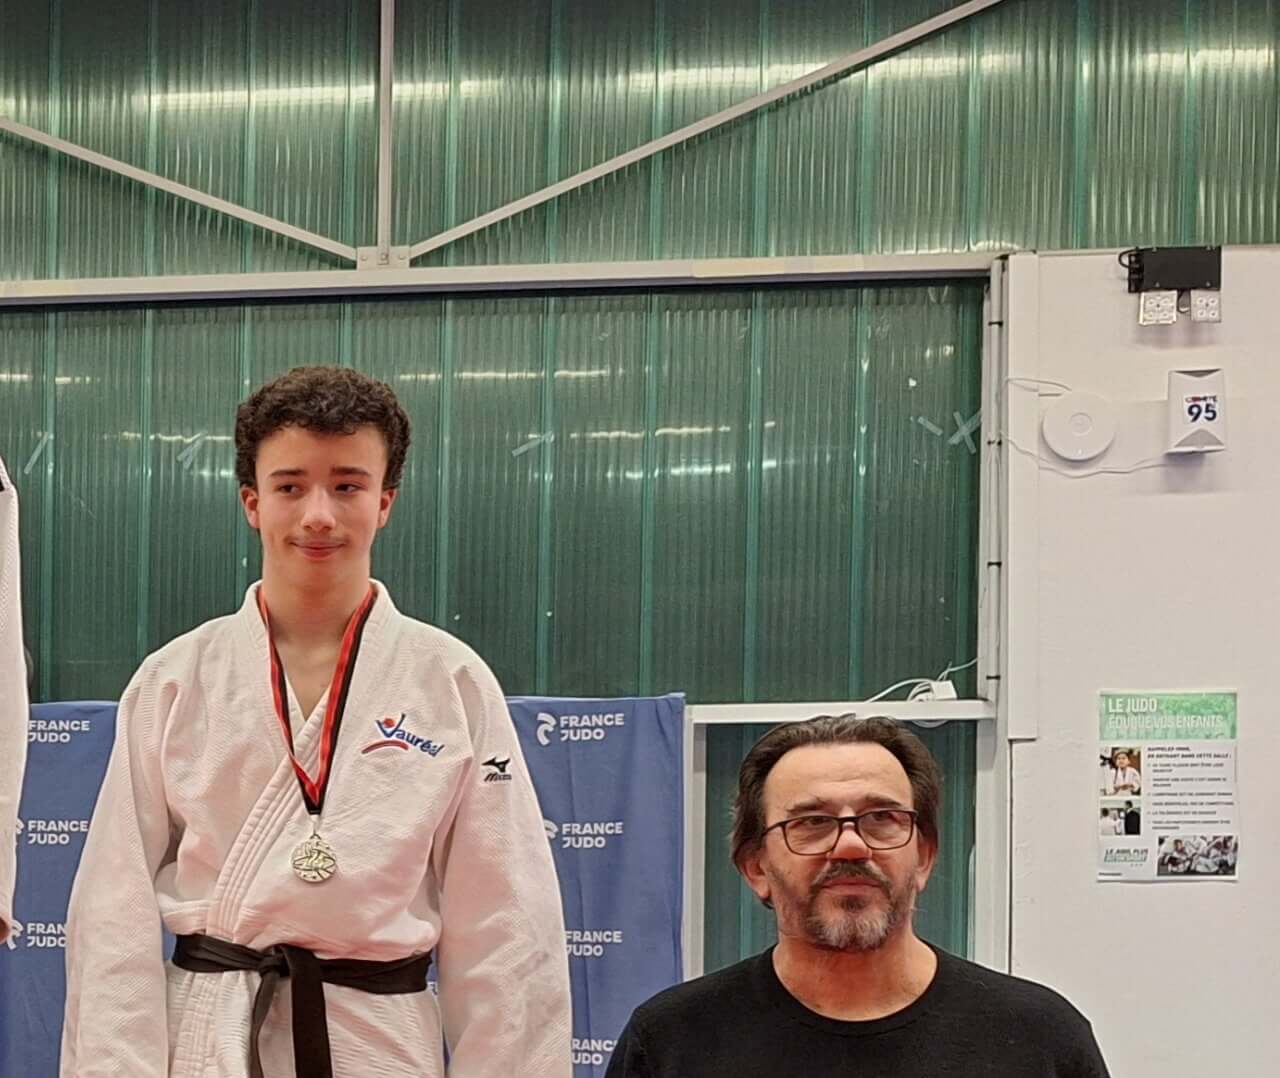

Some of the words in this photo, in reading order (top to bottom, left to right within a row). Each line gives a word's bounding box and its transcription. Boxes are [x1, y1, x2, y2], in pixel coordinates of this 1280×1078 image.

[1187, 404, 1217, 423] 95
[1108, 698, 1123, 713] LE
[1126, 697, 1157, 713] JUDO
[28, 720, 90, 731] FRANCE
[560, 714, 625, 728] FRANCE
[28, 732, 70, 743] JUDO
[560, 728, 605, 741] JUDO
[28, 820, 89, 831] FRANCE
[562, 822, 624, 835] FRANCE
[28, 833, 70, 844] JUDO
[562, 836, 606, 848] JUDO
[27, 923, 65, 934] FRAN
[565, 931, 622, 943] FRANCE
[572, 1039, 618, 1051] RANC
[572, 1052, 603, 1065] UDO
